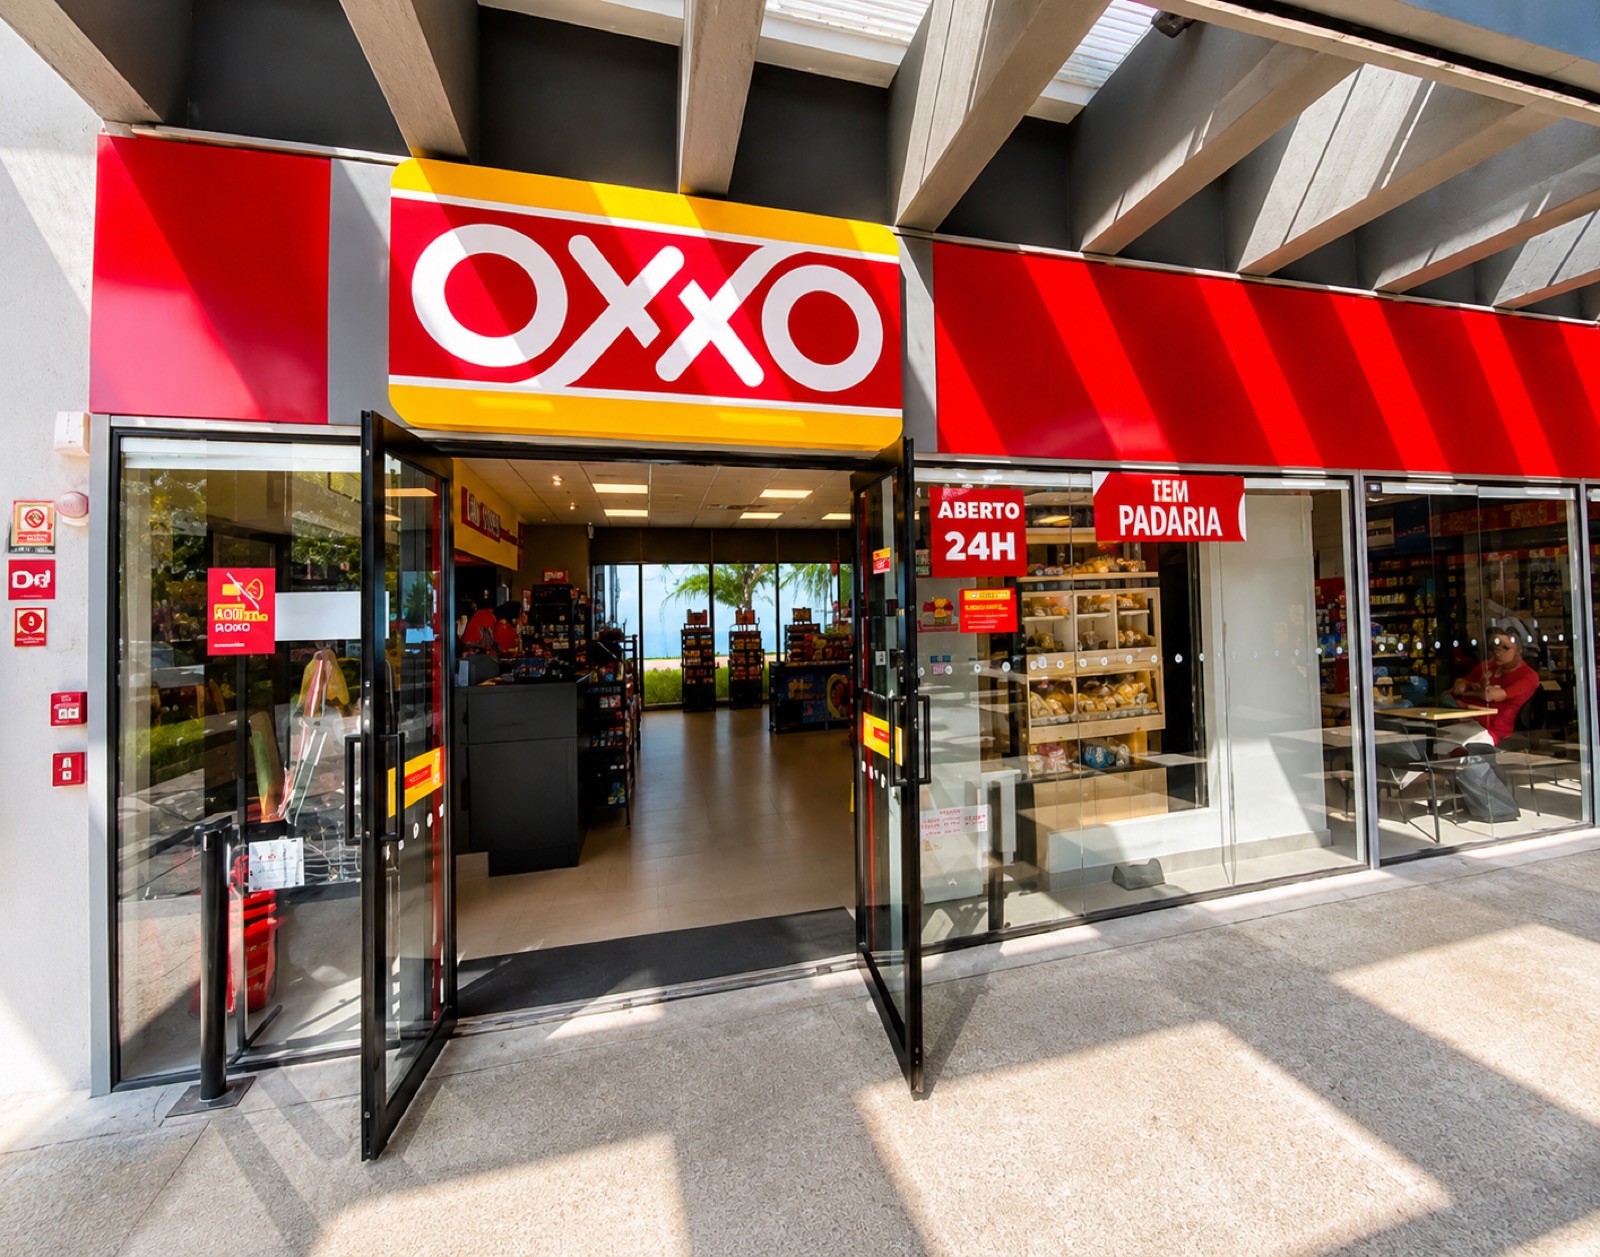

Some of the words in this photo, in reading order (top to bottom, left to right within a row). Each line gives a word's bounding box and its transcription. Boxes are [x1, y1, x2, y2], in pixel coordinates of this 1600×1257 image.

[412, 223, 884, 392] OXXO
[1151, 479, 1189, 503] TEM
[937, 501, 1020, 520] ABERTO
[1119, 504, 1223, 537] PADARIA
[944, 530, 1016, 561] 24H
